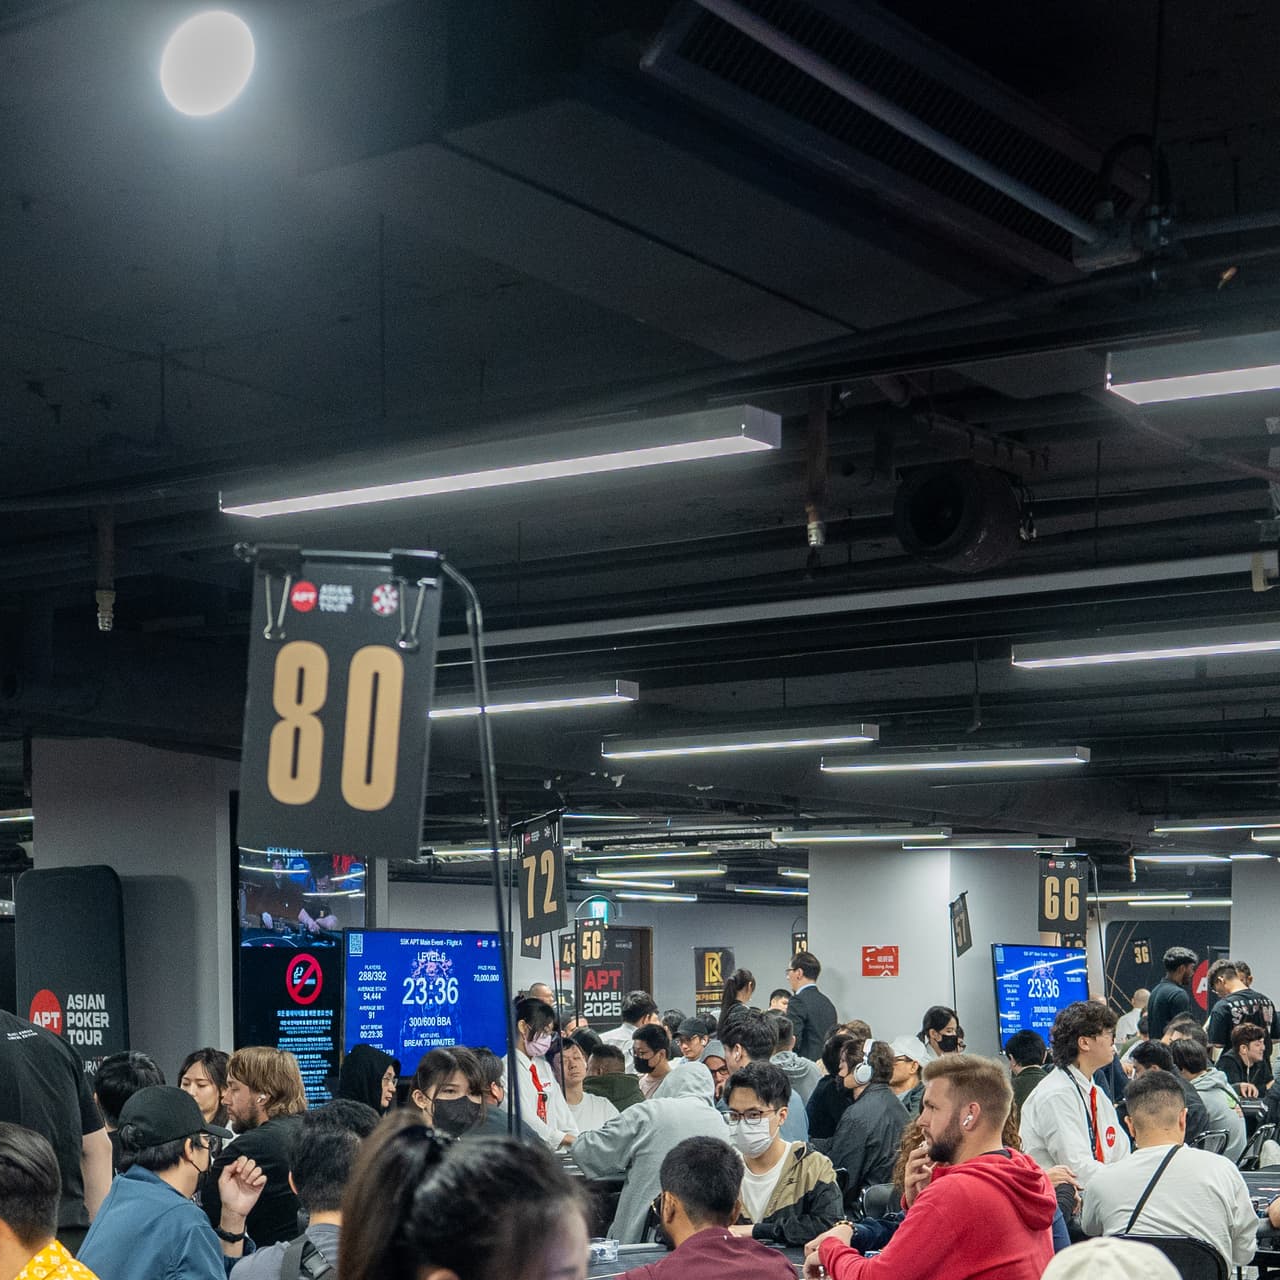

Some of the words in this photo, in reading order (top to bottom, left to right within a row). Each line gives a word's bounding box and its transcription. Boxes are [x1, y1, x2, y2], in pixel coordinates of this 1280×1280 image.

[267, 640, 405, 811] 80
[523, 849, 558, 919] 72
[1044, 876, 1080, 921] 66
[582, 930, 601, 960] 56
[417, 952, 440, 962] LEVEL
[1134, 946, 1149, 964] 36
[358, 971, 387, 981] 288/392
[583, 969, 622, 990] APT
[363, 992, 381, 1000] 54,444
[402, 977, 459, 1005] 23:36
[584, 992, 622, 1000] TAIPEI
[1027, 978, 1060, 998] 23:36
[66, 994, 105, 1010] ASIAN
[584, 1002, 622, 1017] 2025
[33, 1011, 60, 1028] APT
[67, 1012, 110, 1028] POKER
[368, 1011, 375, 1019] 91
[409, 1016, 435, 1027] 300/600
[437, 1016, 452, 1026] BBA
[67, 1029, 103, 1046] TOUR
[404, 1039, 423, 1047] BREAK
[431, 1038, 455, 1046] MINUTES
